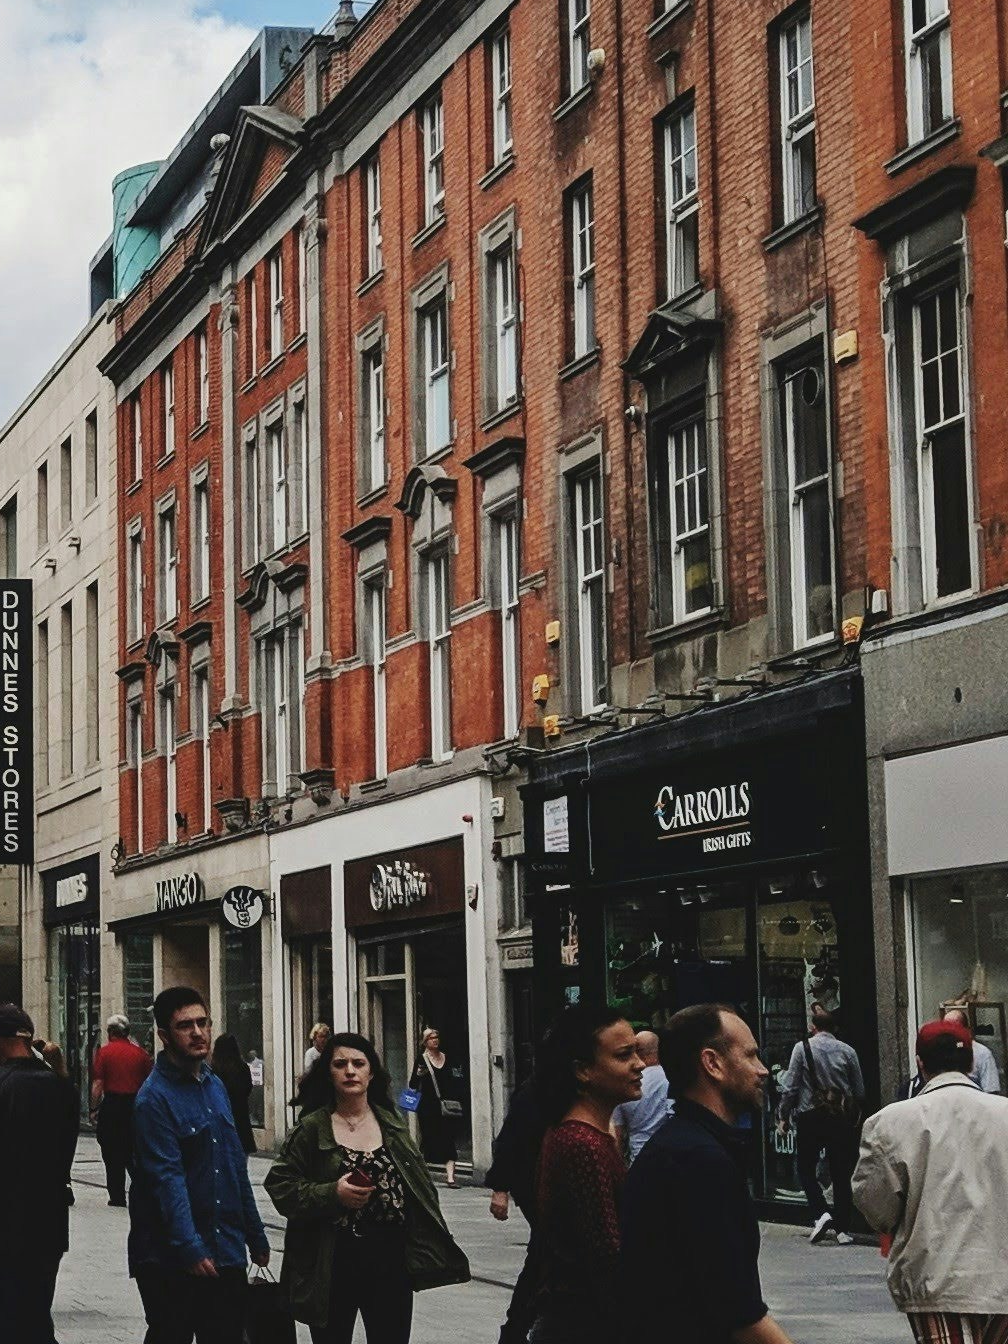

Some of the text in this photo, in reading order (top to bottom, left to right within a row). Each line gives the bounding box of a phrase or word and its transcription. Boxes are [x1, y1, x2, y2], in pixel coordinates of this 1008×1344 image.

[2, 591, 19, 853] DUNNES STORES
[654, 781, 750, 831] CARROLLS
[703, 831, 751, 853] IRISH GIFTS
[156, 872, 198, 912] MANGO
